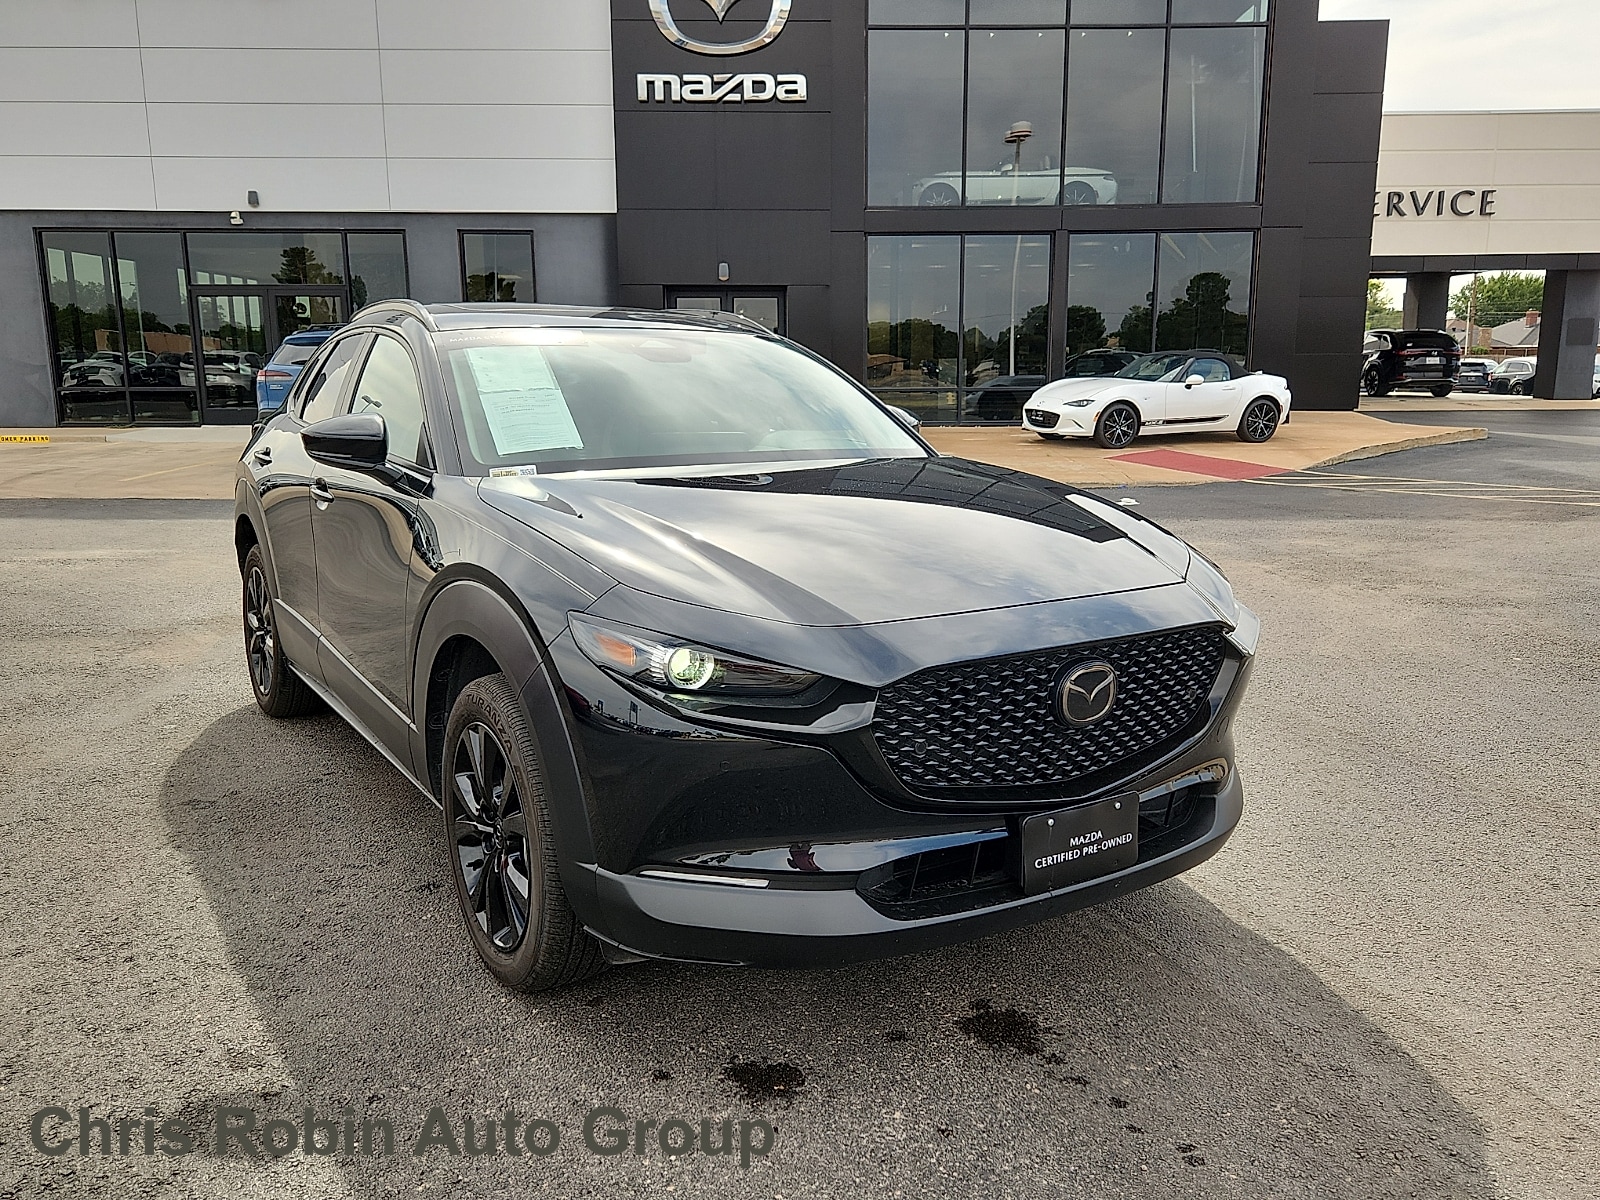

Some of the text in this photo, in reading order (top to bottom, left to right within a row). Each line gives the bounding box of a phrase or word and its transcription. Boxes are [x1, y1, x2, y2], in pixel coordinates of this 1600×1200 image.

[465, 693, 513, 755] TURANZA
[1034, 832, 1133, 869] CERTIFIED PRE-OWNED
[1069, 830, 1103, 848] MAZDA
